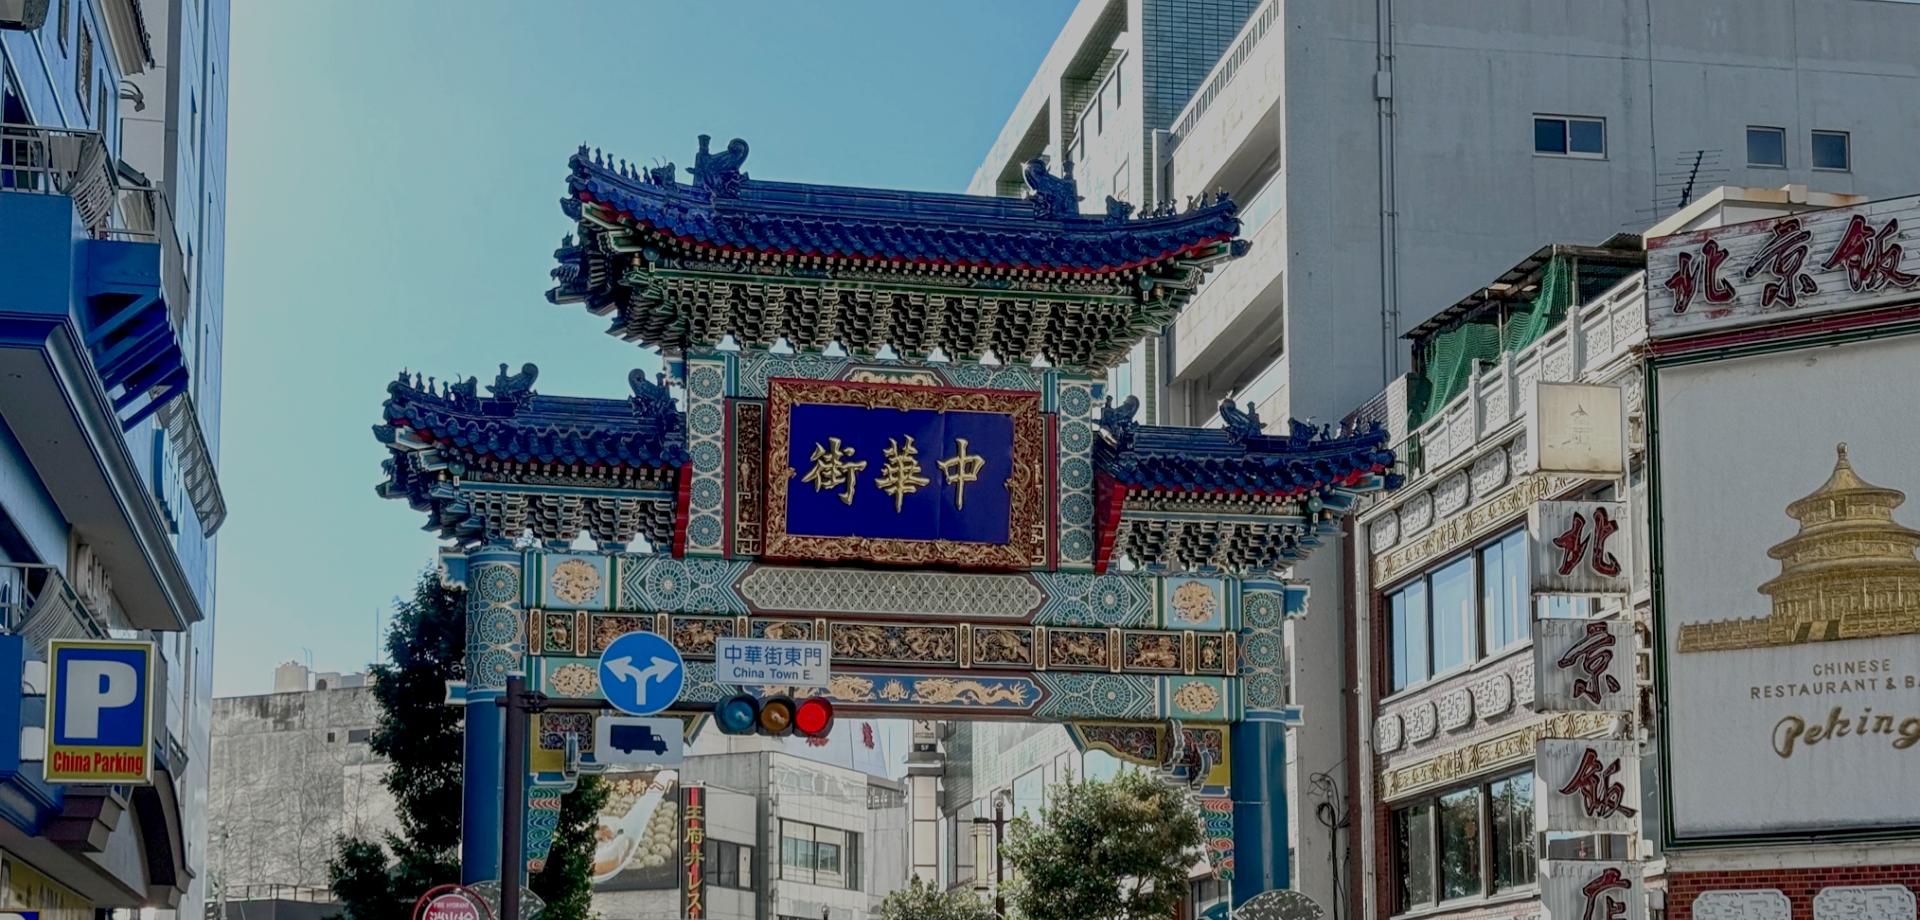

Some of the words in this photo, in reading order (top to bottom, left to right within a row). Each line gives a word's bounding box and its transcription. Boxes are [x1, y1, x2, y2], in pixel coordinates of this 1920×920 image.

[724, 644, 822, 667] 中華街東門
[1813, 659, 1891, 676] CHINESE
[733, 667, 765, 679] China
[769, 668, 798, 680] Town
[64, 659, 137, 739] P
[1750, 678, 1878, 700] RESTAURANT
[1886, 677, 1896, 690] &
[1904, 675, 1920, 689] B
[1772, 704, 1920, 758] Peking
[53, 751, 91, 773] China
[94, 752, 143, 776] Parking
[433, 901, 445, 909] FIRE
[446, 901, 470, 909] HYDRANT
